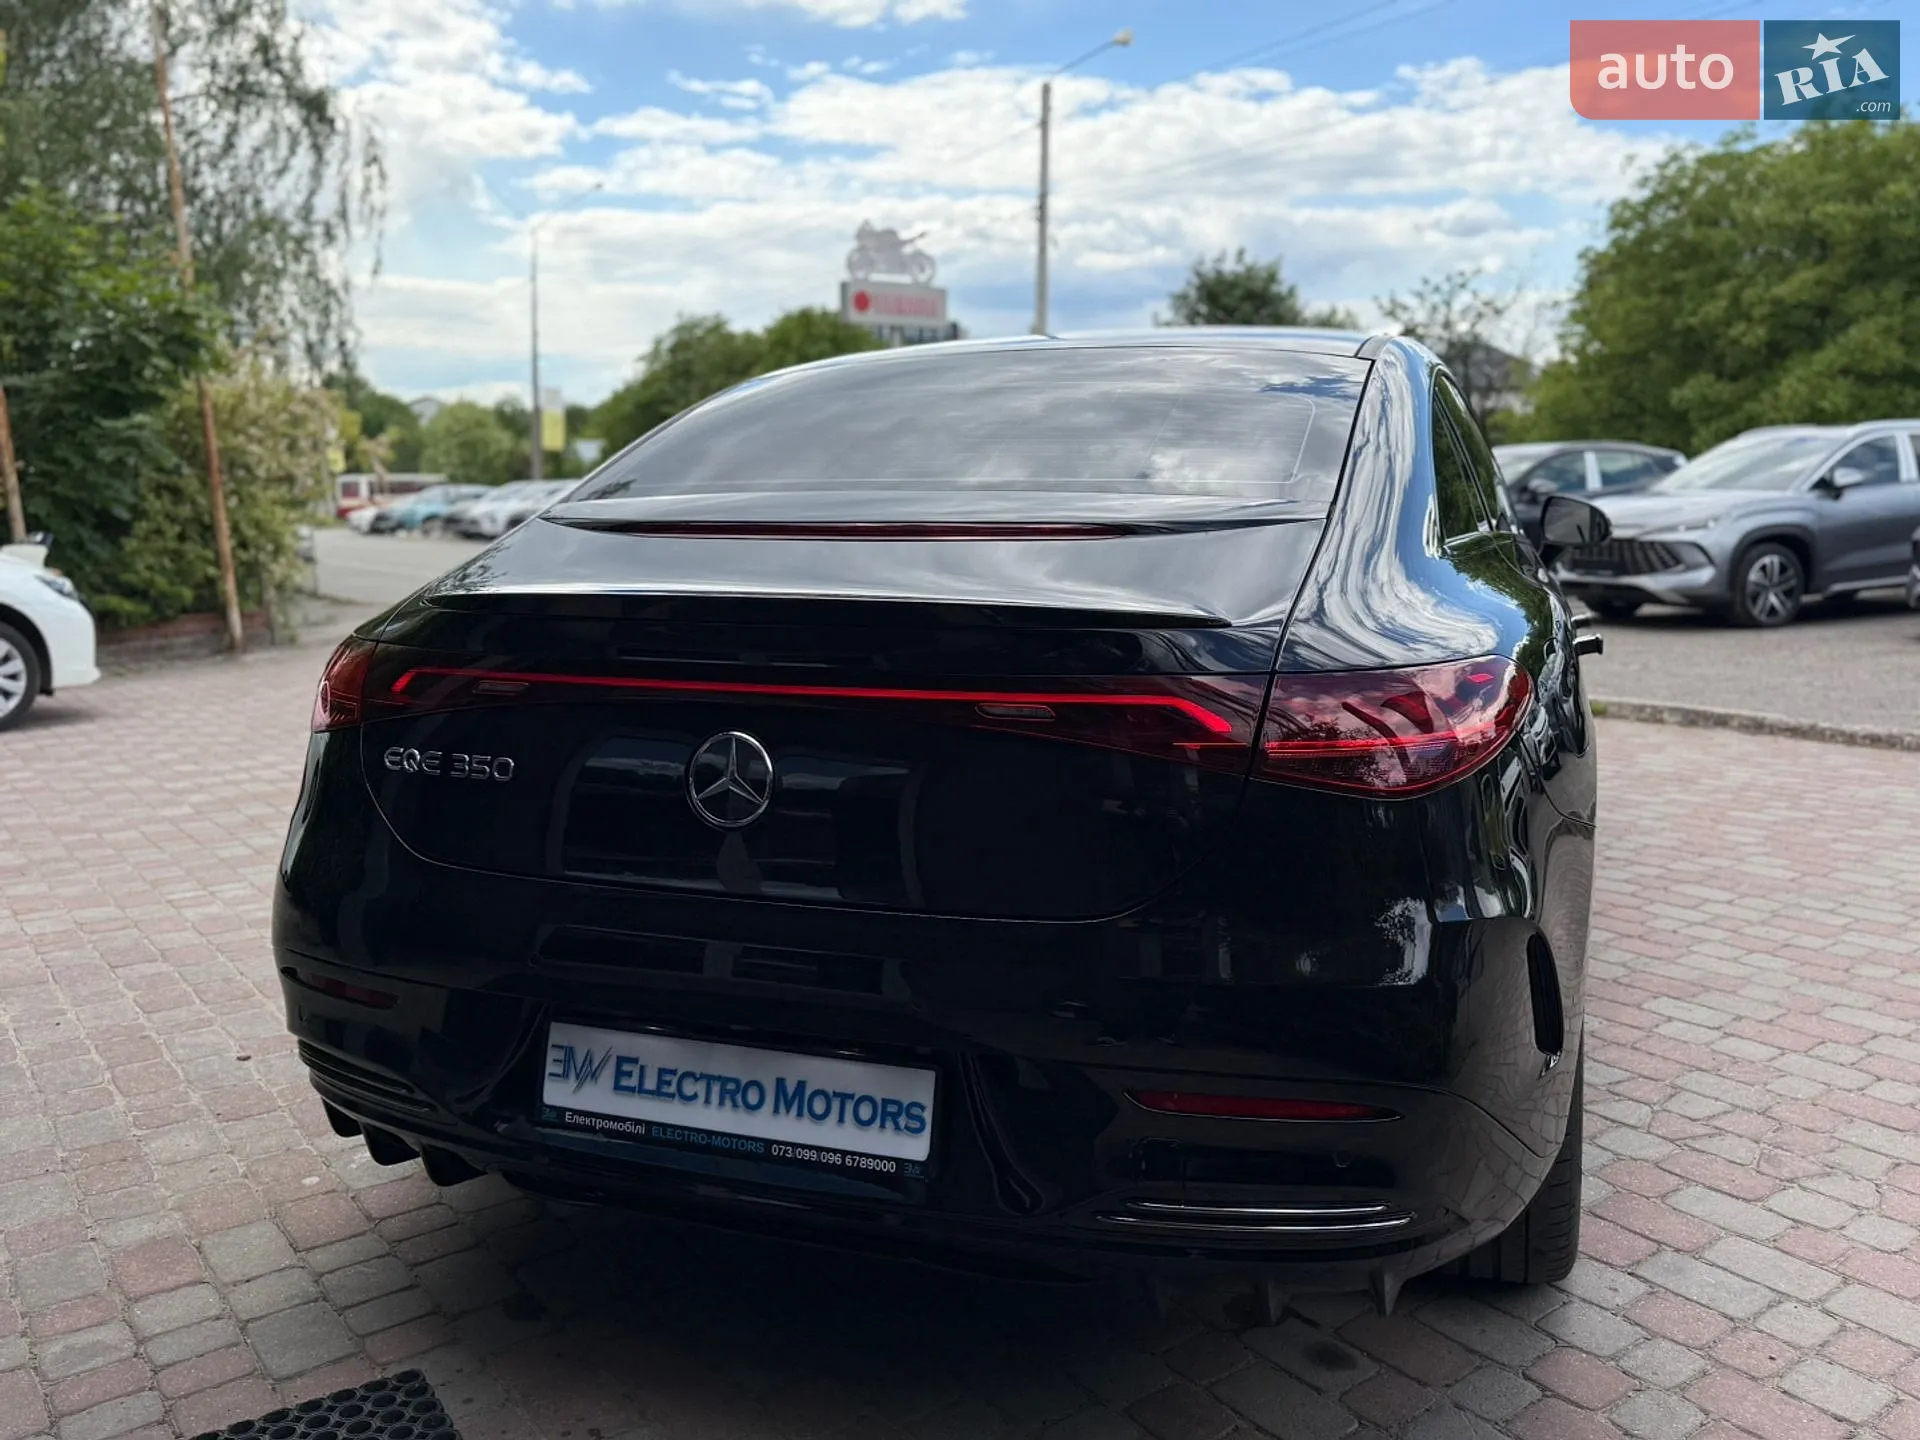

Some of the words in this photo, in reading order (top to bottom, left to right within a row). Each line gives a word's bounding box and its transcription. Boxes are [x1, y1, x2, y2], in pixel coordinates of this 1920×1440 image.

[383, 746, 443, 776] EQE
[449, 753, 515, 782] 350
[612, 1054, 766, 1112] ELECTRO
[772, 1076, 927, 1136] MOTORS
[564, 1111, 646, 1135] Електромобілі
[651, 1125, 765, 1154] ELECTRO-MOTORS
[844, 1154, 897, 1174] 6789000
